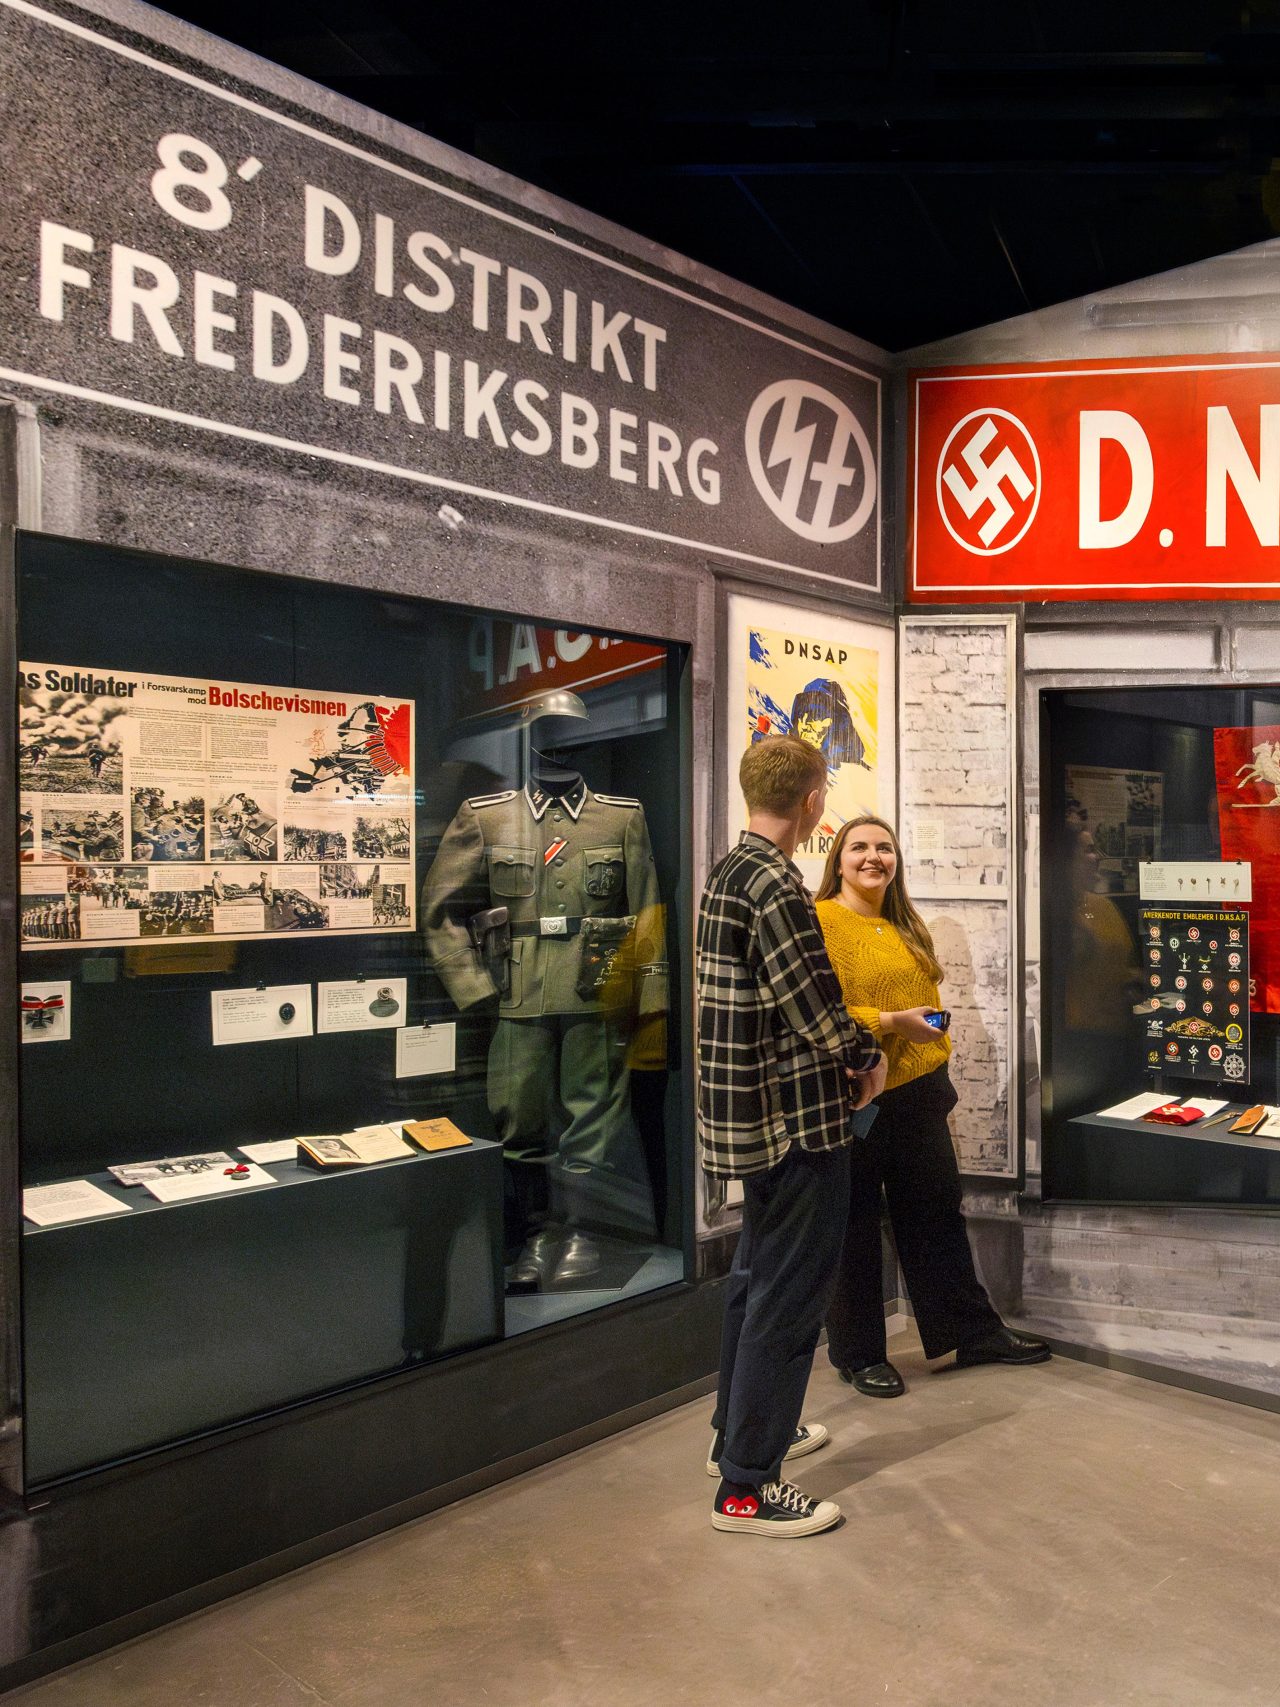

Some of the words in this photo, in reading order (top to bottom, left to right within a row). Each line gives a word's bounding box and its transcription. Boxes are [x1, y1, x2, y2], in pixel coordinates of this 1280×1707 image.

[304, 184, 667, 392] DISTRIKT
[38, 220, 721, 506] FREDERIKSBERG
[784, 639, 848, 665] DNSAP
[45, 669, 138, 698] Soldater
[147, 682, 206, 696] Forsvarskamp
[187, 697, 206, 705] mod
[208, 686, 347, 717] Bolschevismen
